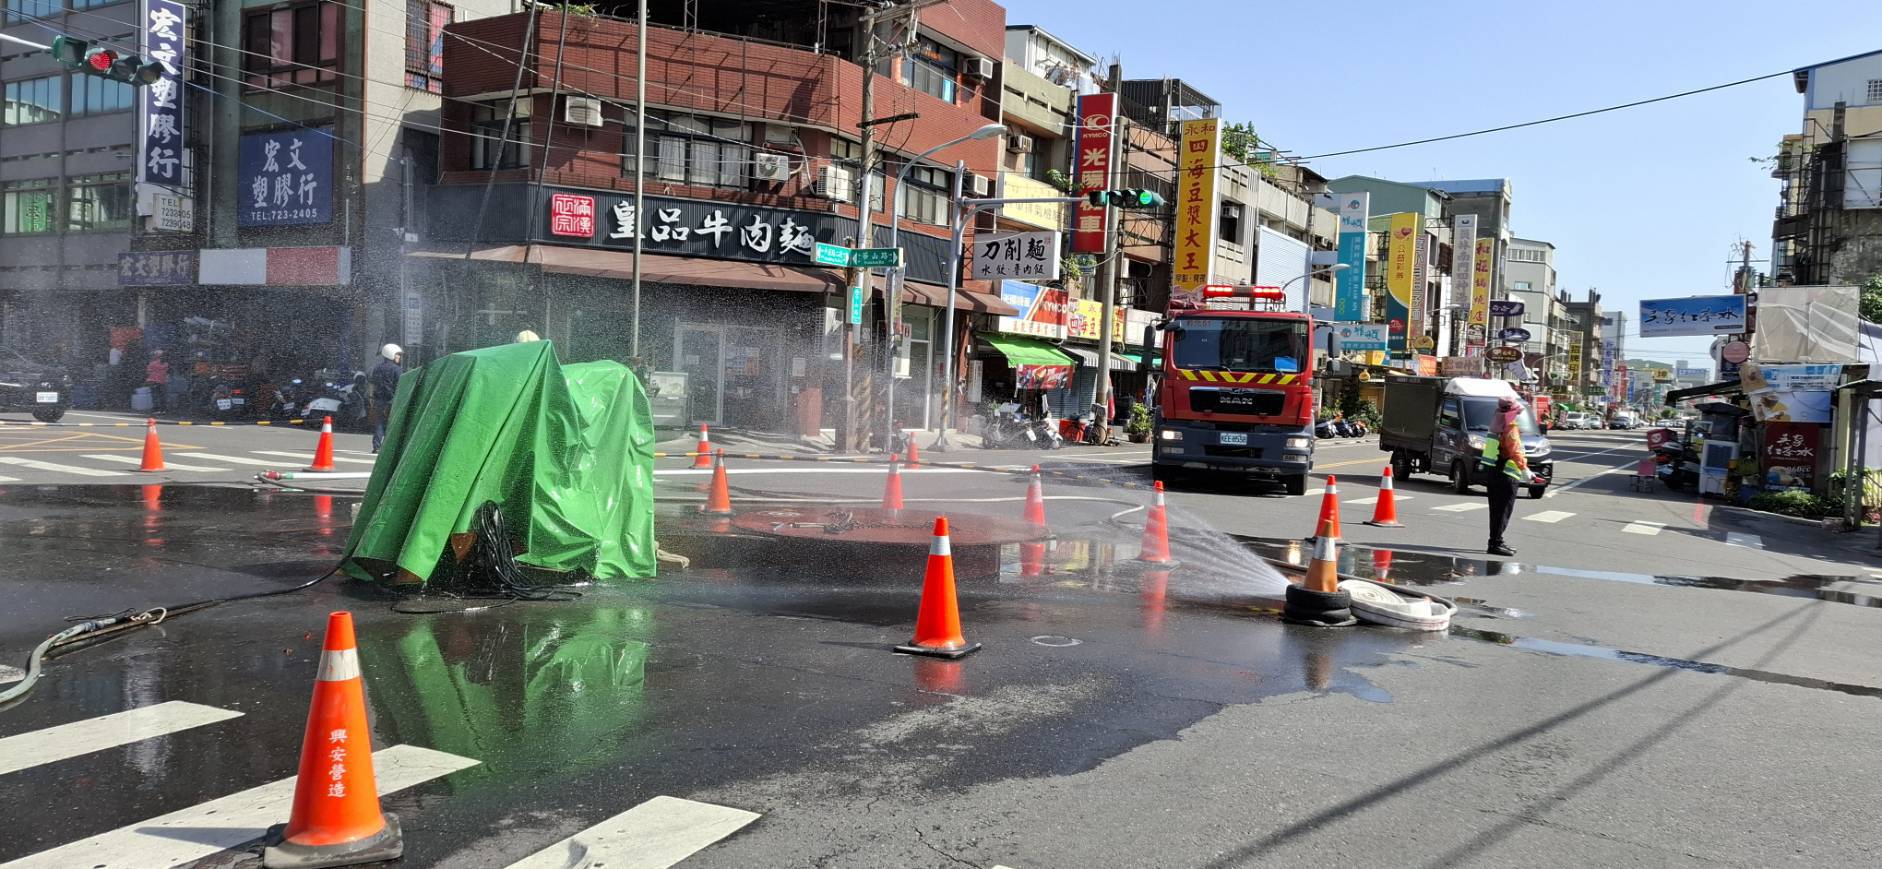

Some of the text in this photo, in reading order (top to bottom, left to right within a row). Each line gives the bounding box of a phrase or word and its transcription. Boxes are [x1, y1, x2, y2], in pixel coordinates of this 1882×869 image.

[148, 7, 182, 178] 宏文塑膠行
[1184, 123, 1216, 136] 永和
[262, 138, 307, 173] 宏文
[252, 173, 318, 208] 塑膠行
[1183, 138, 1209, 271] 四海豆漿大王
[610, 200, 816, 256] 皇品牛肉麵
[980, 237, 1048, 262] 刀削麵
[1219, 397, 1253, 405] MAN
[327, 729, 348, 798] 興安營造
